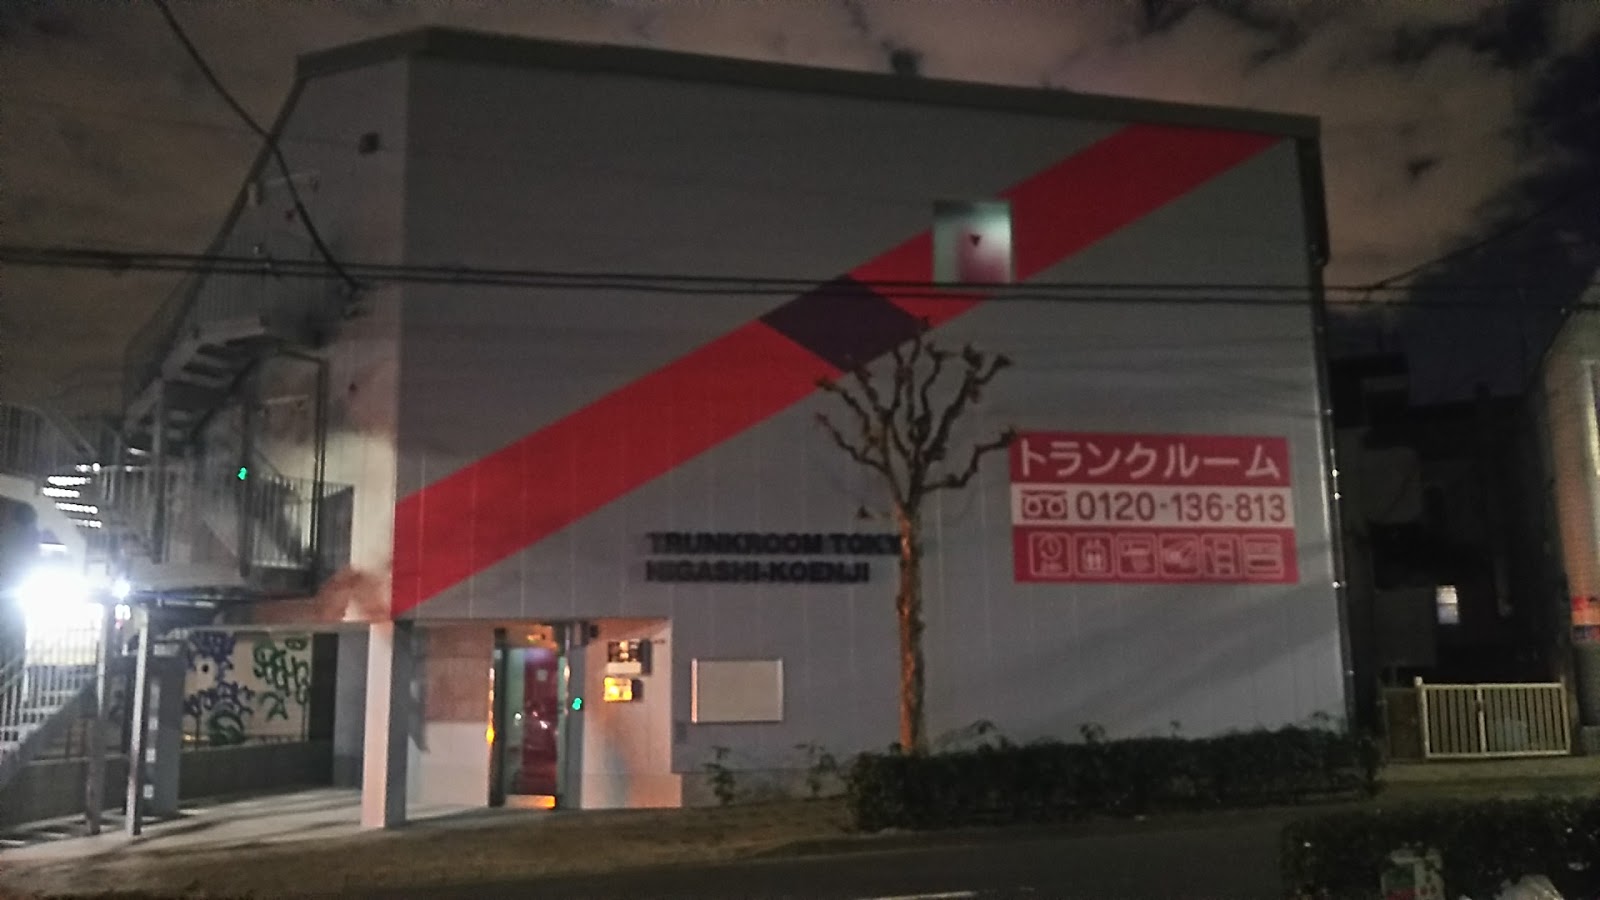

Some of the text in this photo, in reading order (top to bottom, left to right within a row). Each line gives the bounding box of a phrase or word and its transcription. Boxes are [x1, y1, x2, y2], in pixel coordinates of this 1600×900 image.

[1020, 438, 1281, 479] トランクルーム
[1076, 491, 1286, 522] 0120-136-813
[648, 532, 905, 555] TRUNKROOM TOKY
[646, 560, 870, 583] HIGASHI-KOENJI
